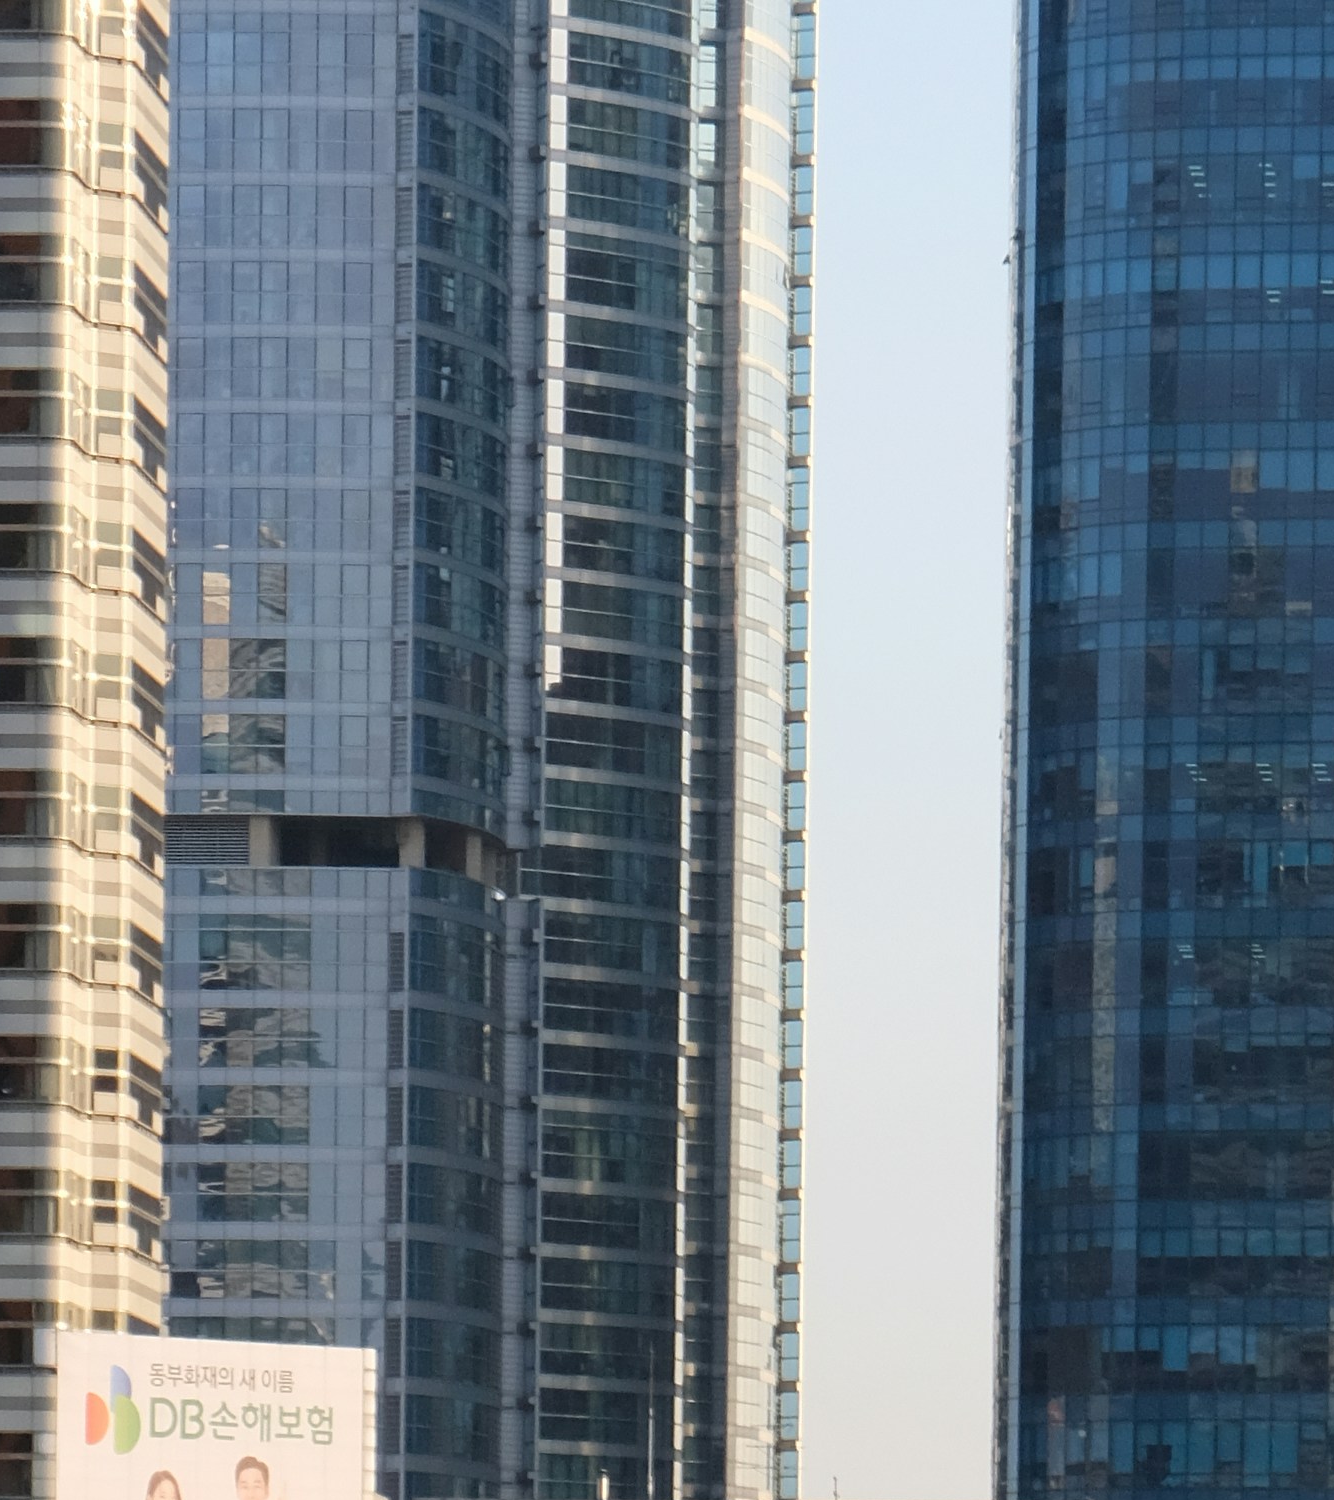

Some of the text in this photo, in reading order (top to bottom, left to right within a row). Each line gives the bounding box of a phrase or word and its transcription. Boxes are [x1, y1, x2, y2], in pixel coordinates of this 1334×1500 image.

[149, 1363, 295, 1393] 동부화재의 새 이름
[149, 1397, 334, 1445] DB손해보험
